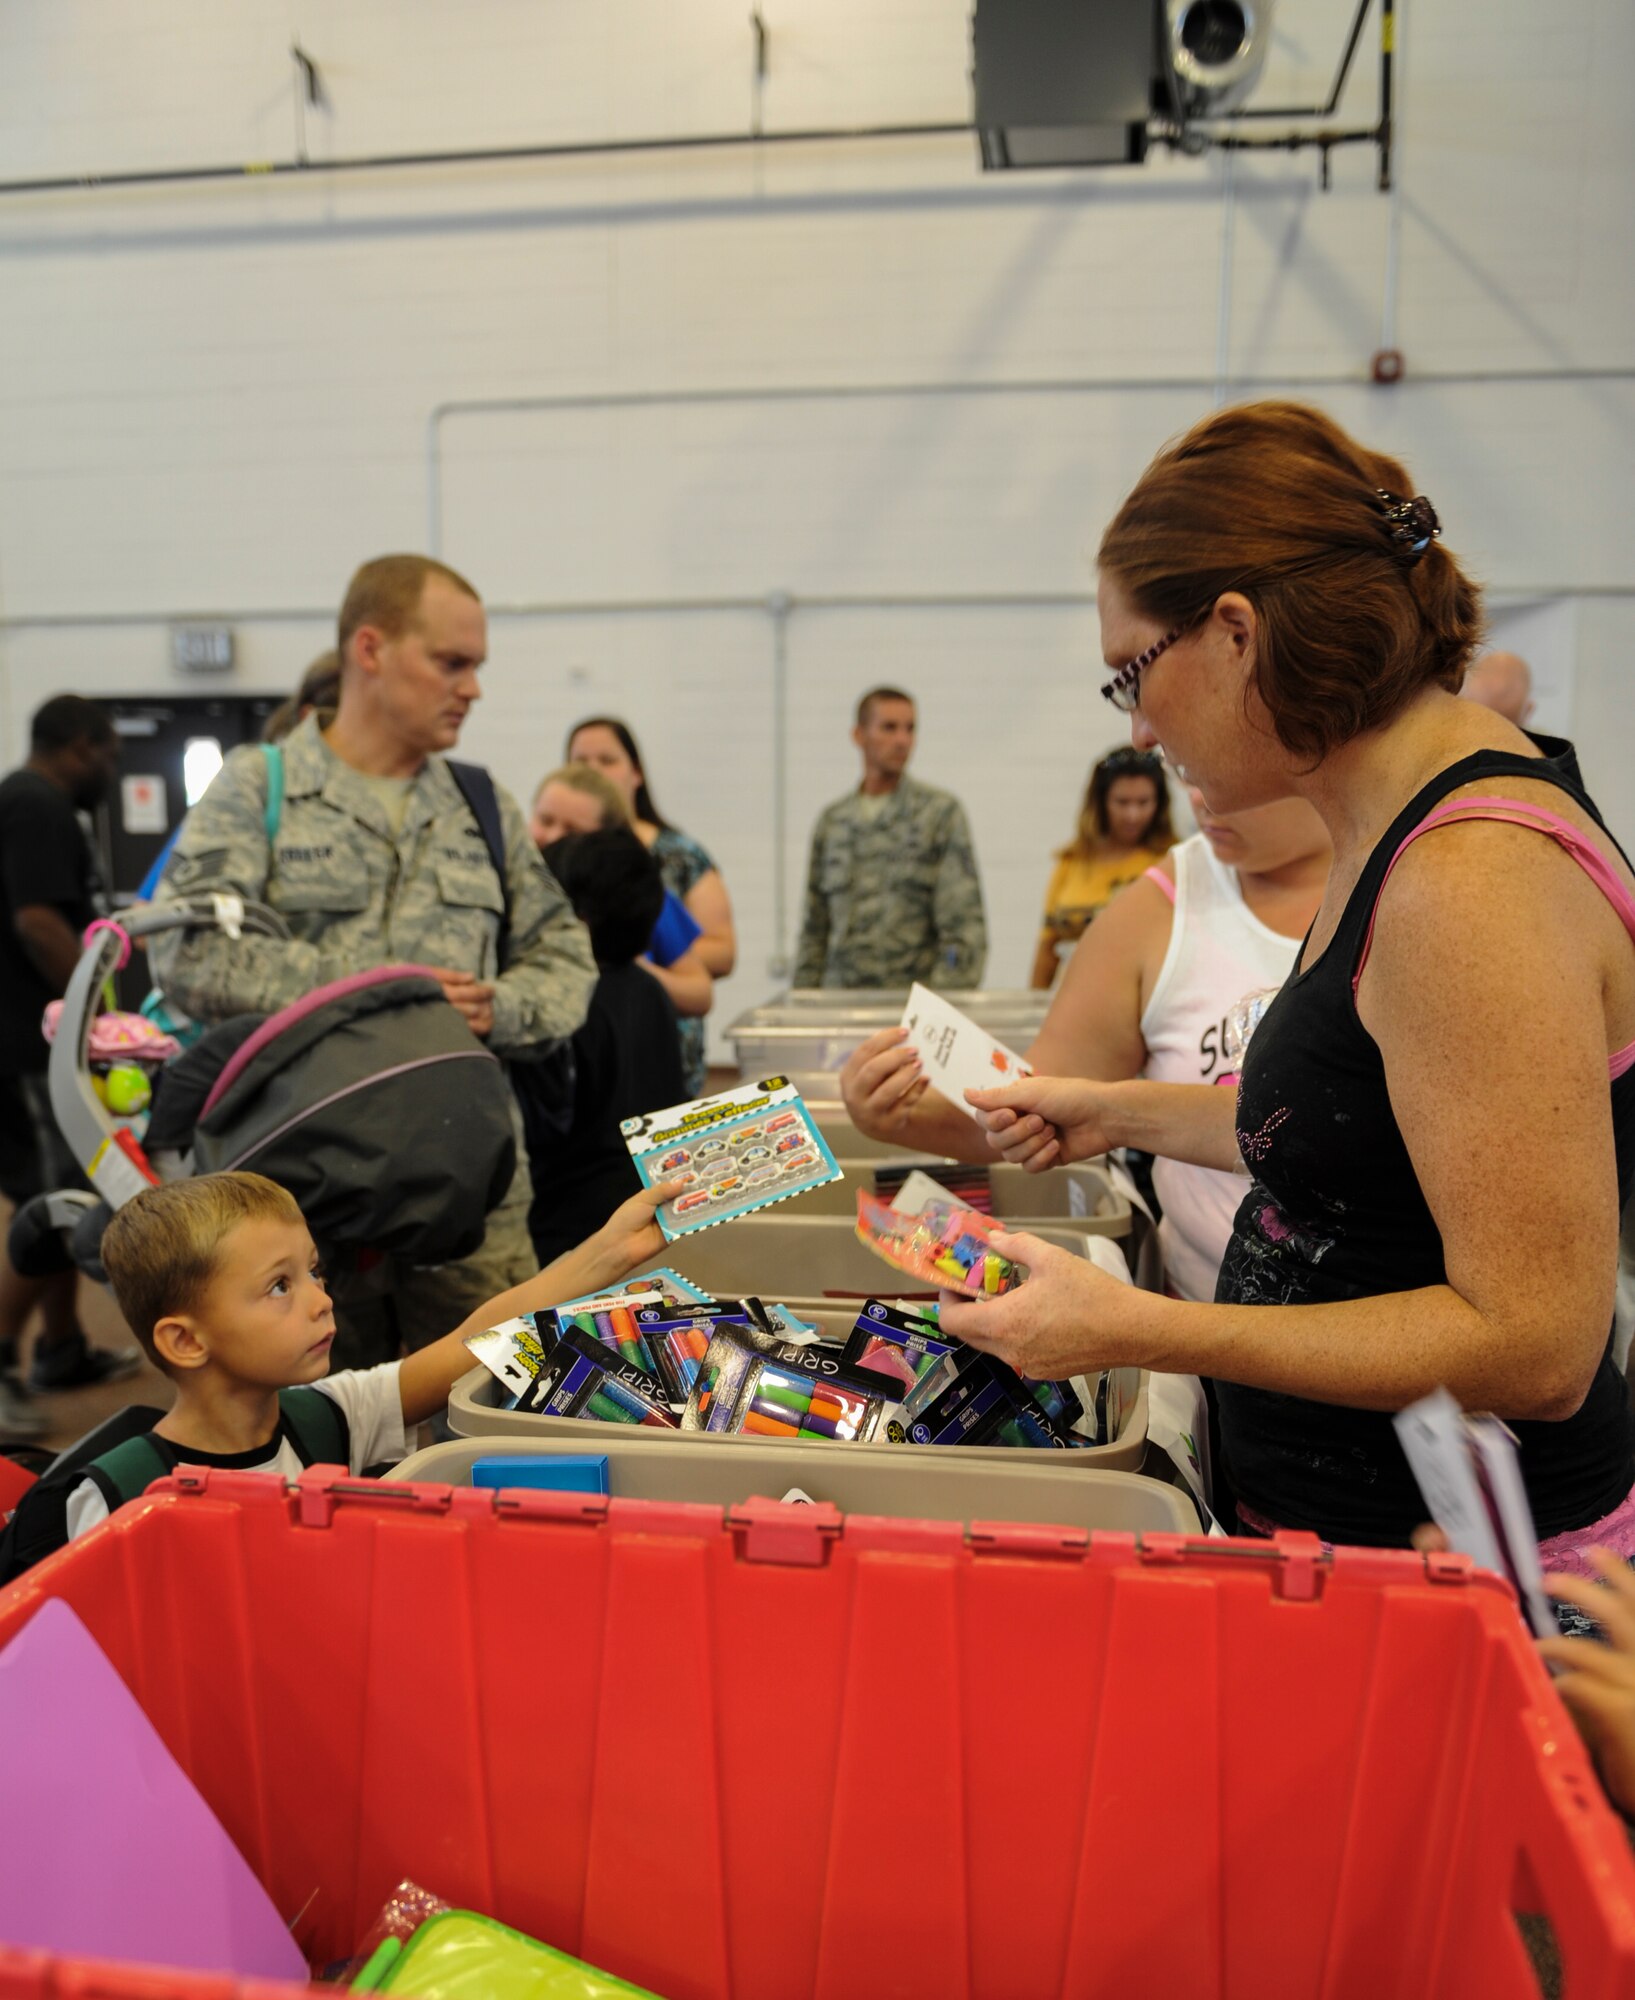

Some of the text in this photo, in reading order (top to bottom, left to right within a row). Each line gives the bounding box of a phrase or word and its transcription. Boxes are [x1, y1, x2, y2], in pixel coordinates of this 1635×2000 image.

[905, 1339, 927, 1351] PRISES
[908, 1335, 928, 1345] GRIPS
[550, 1388, 566, 1408] GRIPS
[555, 1391, 573, 1413] PRISES
[957, 1405, 974, 1422] GRIPS
[961, 1411, 980, 1430] PRISES
